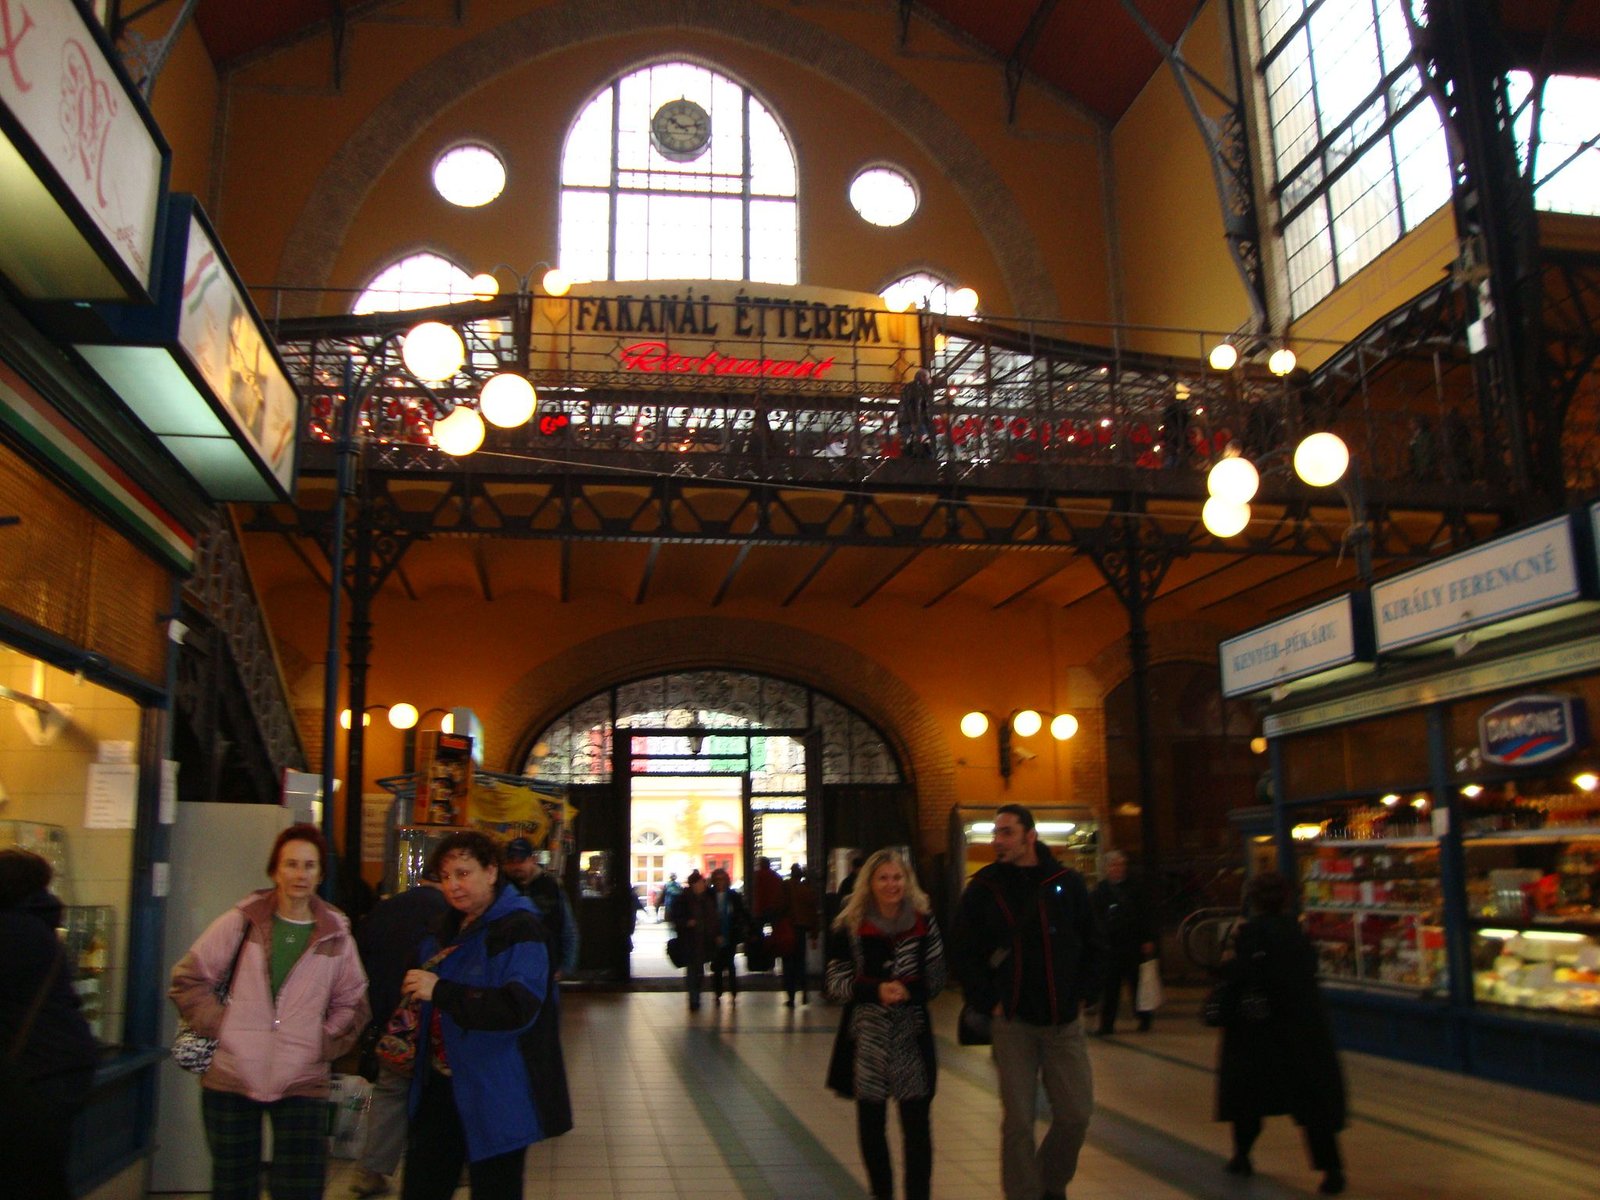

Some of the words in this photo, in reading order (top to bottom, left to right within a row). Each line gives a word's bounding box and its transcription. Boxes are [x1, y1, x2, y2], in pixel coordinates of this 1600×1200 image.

[576, 288, 718, 333] FAKANÁL
[734, 288, 881, 343] ÉTTEREM
[618, 341, 836, 380] Restaurant
[1487, 707, 1564, 742] DANONE
